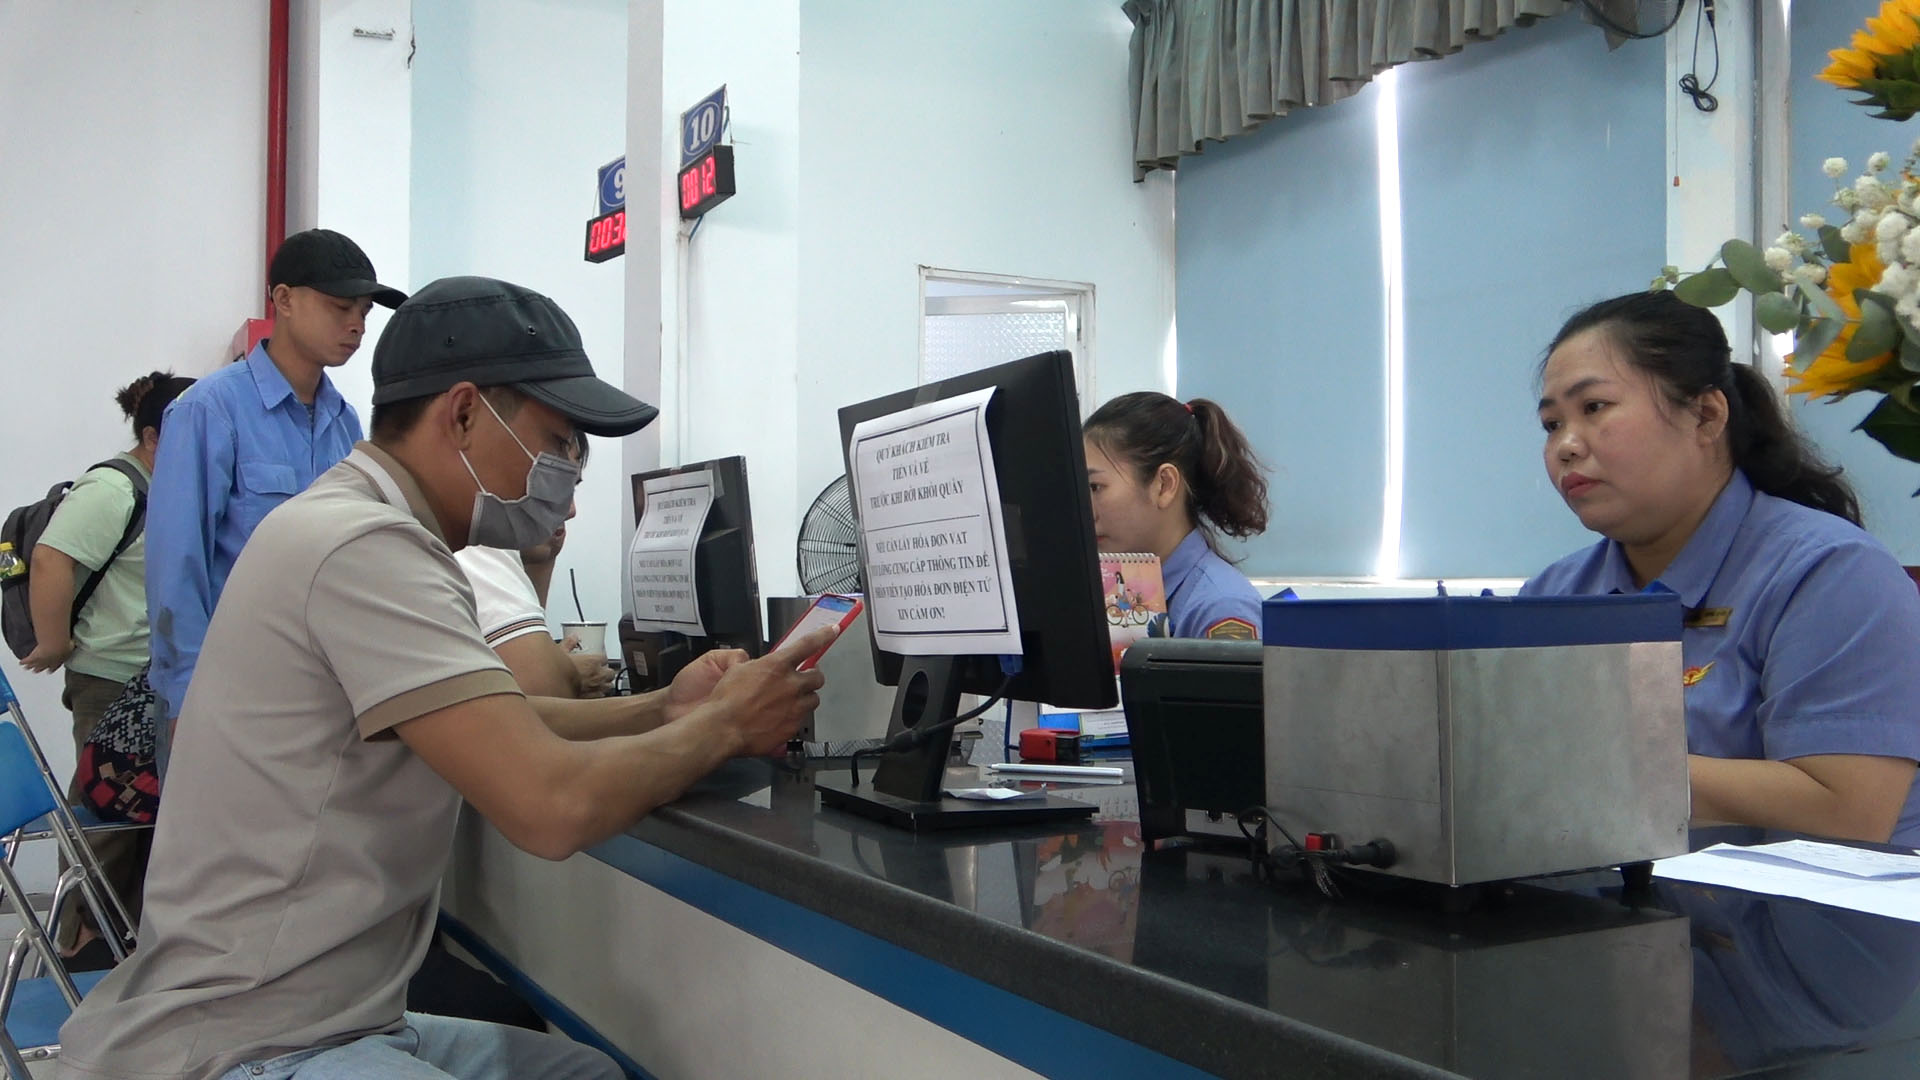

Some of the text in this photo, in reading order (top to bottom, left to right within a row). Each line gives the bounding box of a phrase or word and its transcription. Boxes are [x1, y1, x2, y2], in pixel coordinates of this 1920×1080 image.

[690, 106, 715, 151] 10
[613, 167, 626, 200] 9
[682, 155, 716, 210] 0012
[589, 212, 627, 253] 003
[876, 444, 890, 464] QUÝ
[891, 440, 916, 458] KHÁCH
[936, 431, 951, 446] TRA
[891, 491, 903, 505] KHI
[917, 481, 938, 500] KHỎI
[949, 531, 967, 545] VAT
[926, 554, 957, 572] THÔNG
[957, 555, 975, 569] TIN
[953, 579, 976, 597] ĐIỆN
[897, 608, 909, 621] XIN
